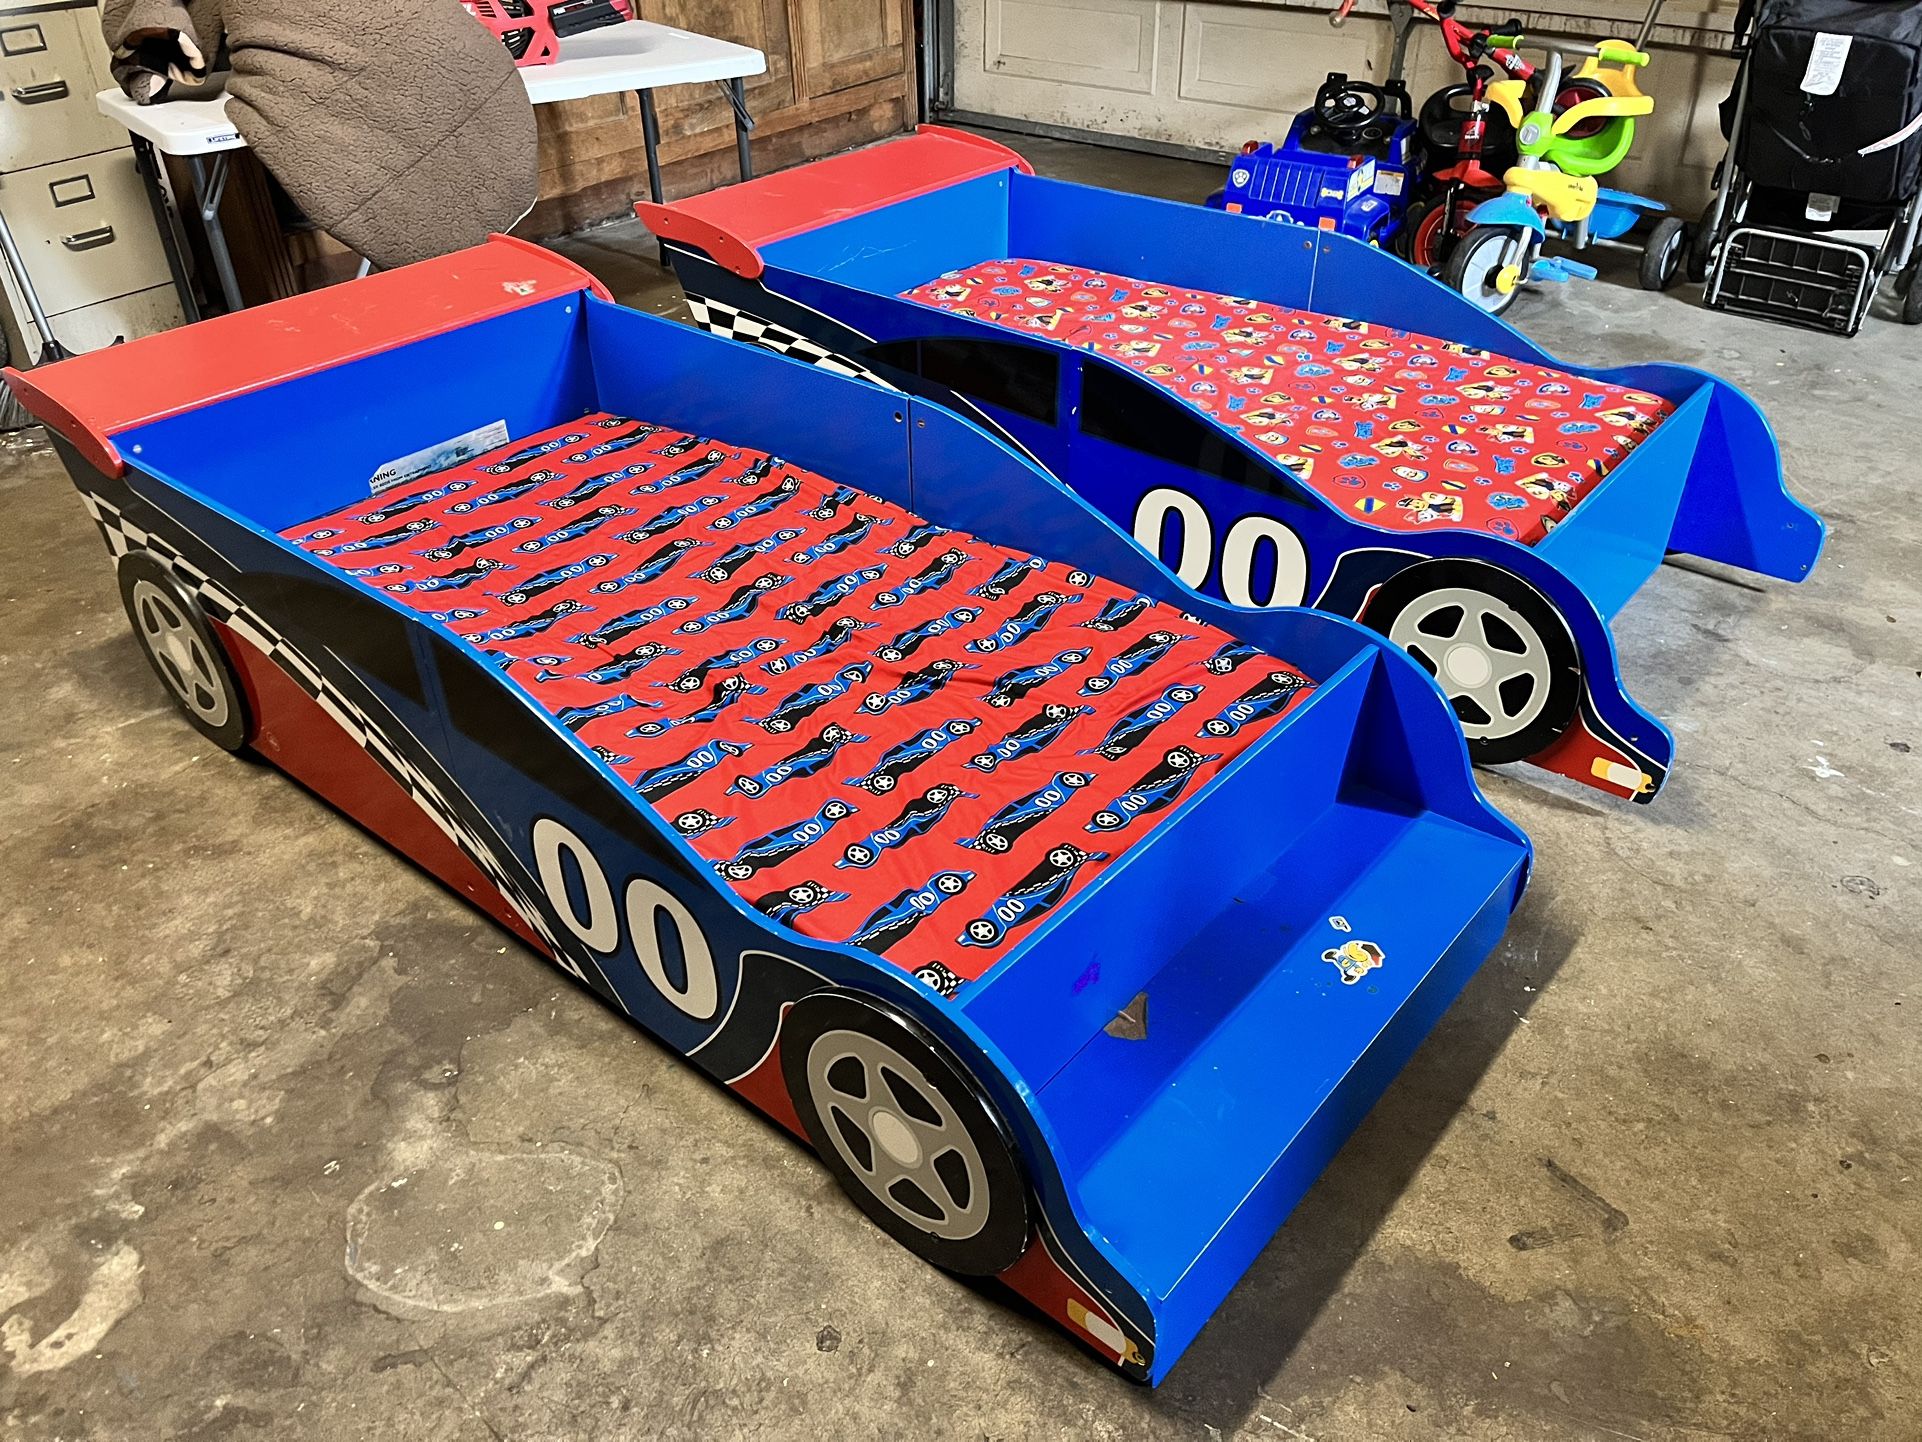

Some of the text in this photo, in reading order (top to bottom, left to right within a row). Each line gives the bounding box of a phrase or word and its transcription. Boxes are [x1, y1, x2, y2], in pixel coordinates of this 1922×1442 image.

[541, 442, 560, 453] 00
[593, 444, 612, 455] 00
[370, 469, 396, 483] NING
[604, 472, 623, 484] 00
[662, 475, 681, 487] 00
[422, 490, 443, 501] 00
[478, 493, 499, 505] 00
[737, 506, 757, 518] 00
[485, 526, 507, 539] 00
[547, 531, 569, 543] 00
[342, 541, 368, 552] 00
[755, 539, 774, 552] 00
[1133, 487, 1308, 609] 00
[560, 564, 583, 578] 00
[625, 571, 646, 583] 00
[836, 575, 857, 593] 00
[640, 606, 663, 622] 00
[707, 611, 730, 623] 00
[490, 627, 516, 641] 00
[794, 648, 817, 663] 00
[1110, 659, 1133, 674] 00
[888, 689, 912, 705] 00
[1147, 702, 1172, 720] 00
[1229, 703, 1255, 721] 00
[921, 730, 947, 750] 00
[686, 750, 714, 769] 00
[764, 765, 793, 783] 00
[1034, 789, 1061, 809] 00
[1121, 794, 1148, 812] 00
[792, 822, 821, 843] 00
[873, 829, 901, 845] 00
[997, 898, 1026, 923] 00
[532, 817, 719, 1021] 00
